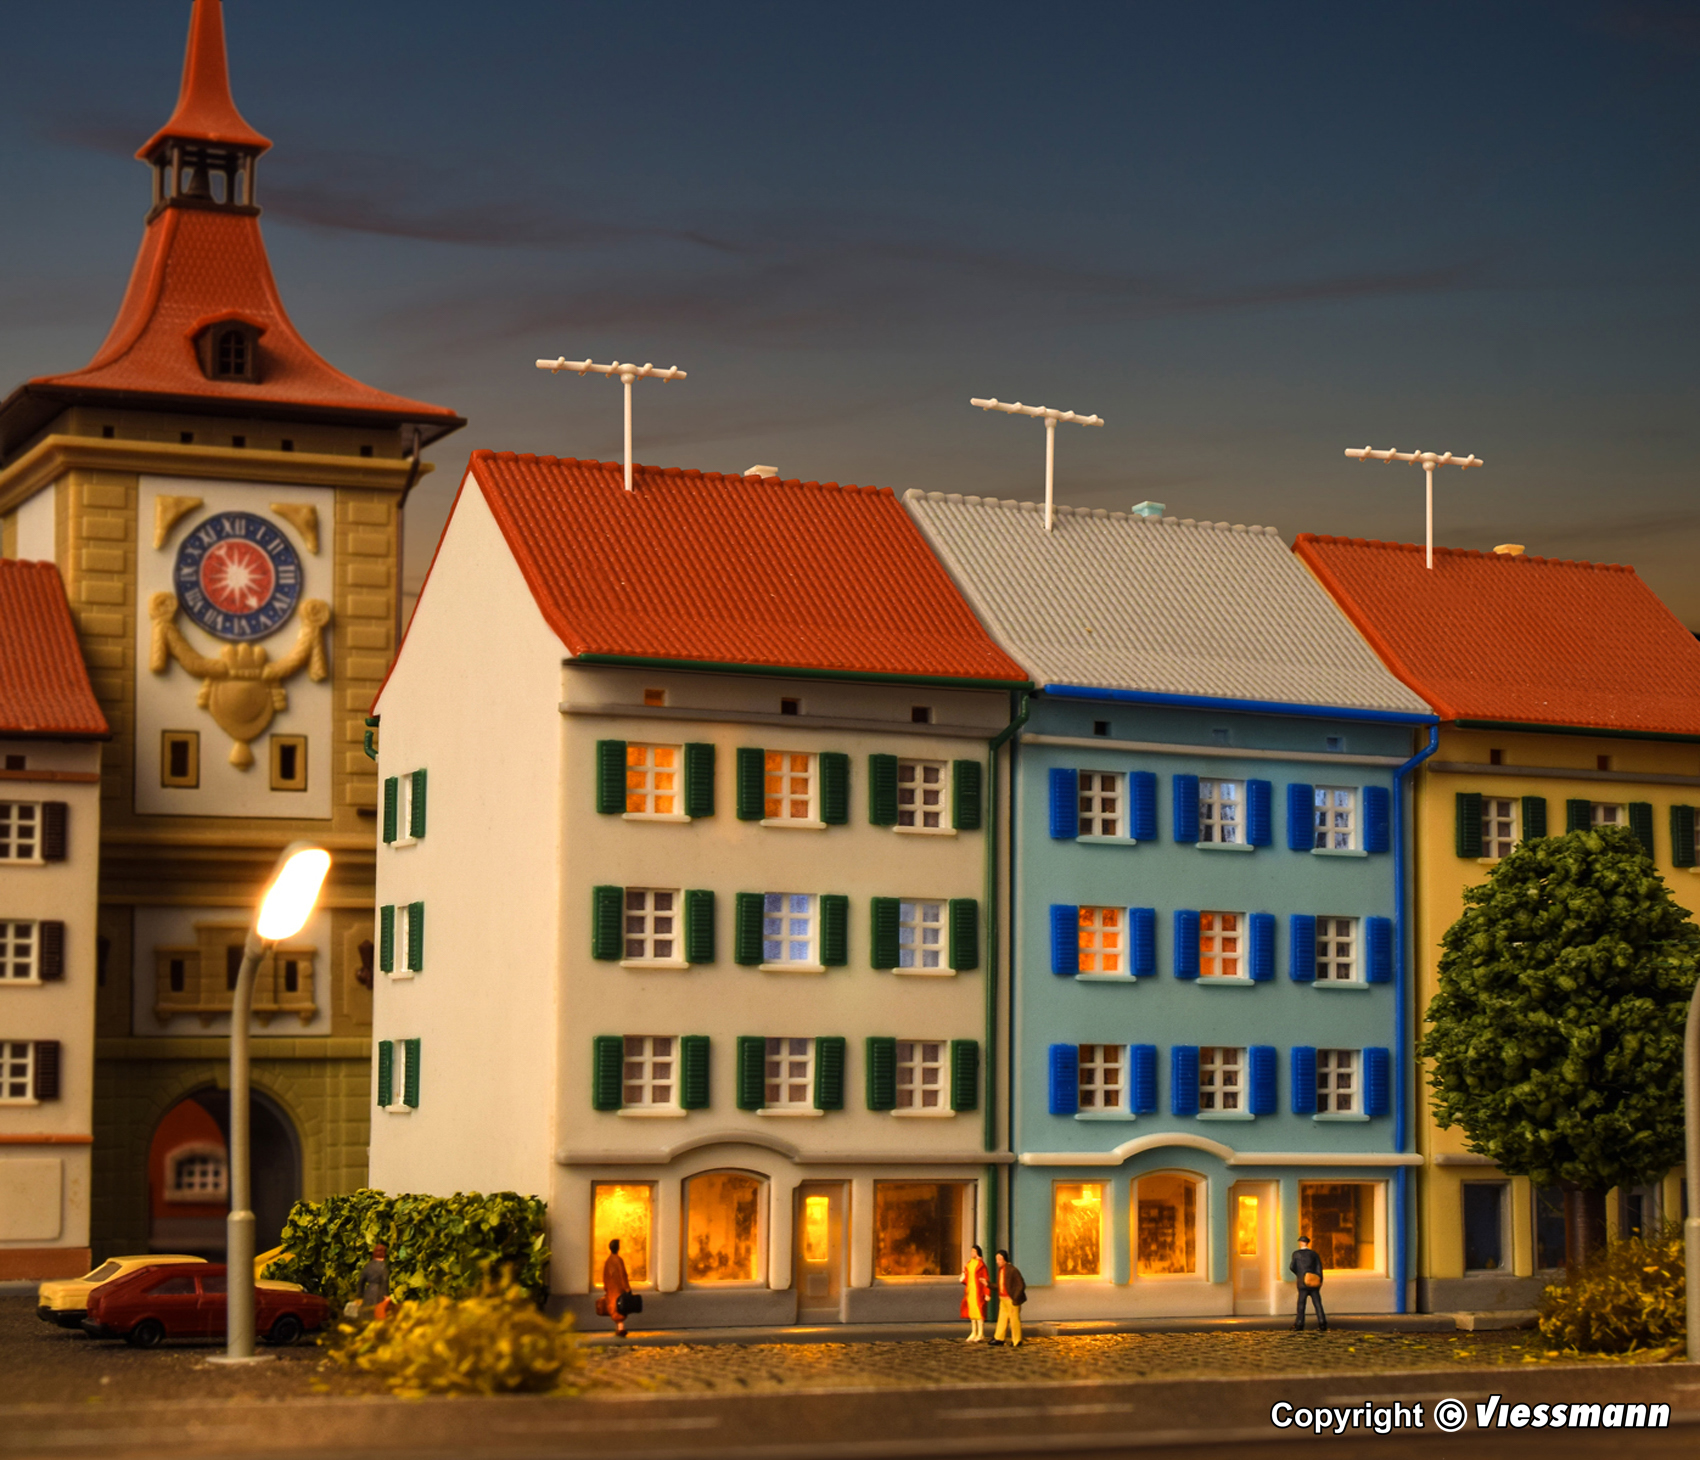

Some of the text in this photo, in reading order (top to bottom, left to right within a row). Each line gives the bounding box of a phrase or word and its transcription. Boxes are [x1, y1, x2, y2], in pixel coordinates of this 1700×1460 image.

[221, 518, 246, 536] XII
[256, 526, 266, 539] I
[267, 538, 285, 555] II
[277, 565, 295, 584] III
